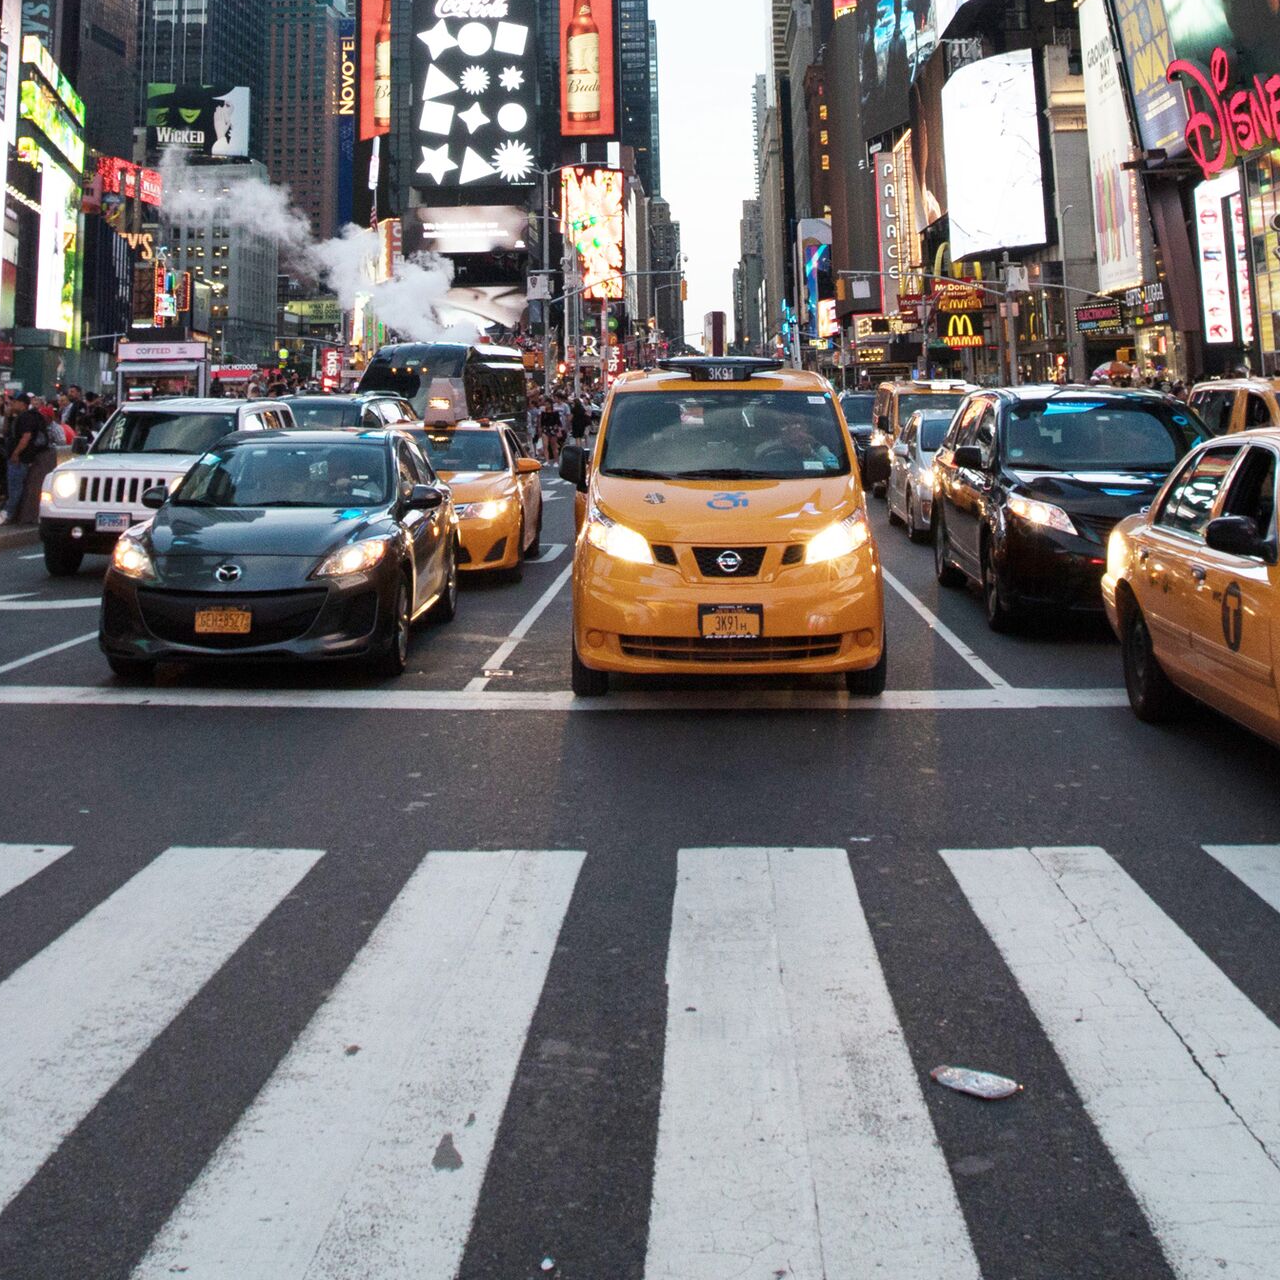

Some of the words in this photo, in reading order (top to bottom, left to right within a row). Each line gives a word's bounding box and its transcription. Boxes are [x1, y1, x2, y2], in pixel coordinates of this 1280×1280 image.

[339, 34, 355, 115] NOVOTEL
[156, 126, 205, 144] WICKED
[883, 163, 899, 278] PALACE
[1077, 307, 1119, 322] ELECTRONICS
[582, 335, 600, 357] R
[708, 367, 734, 380] 3K91
